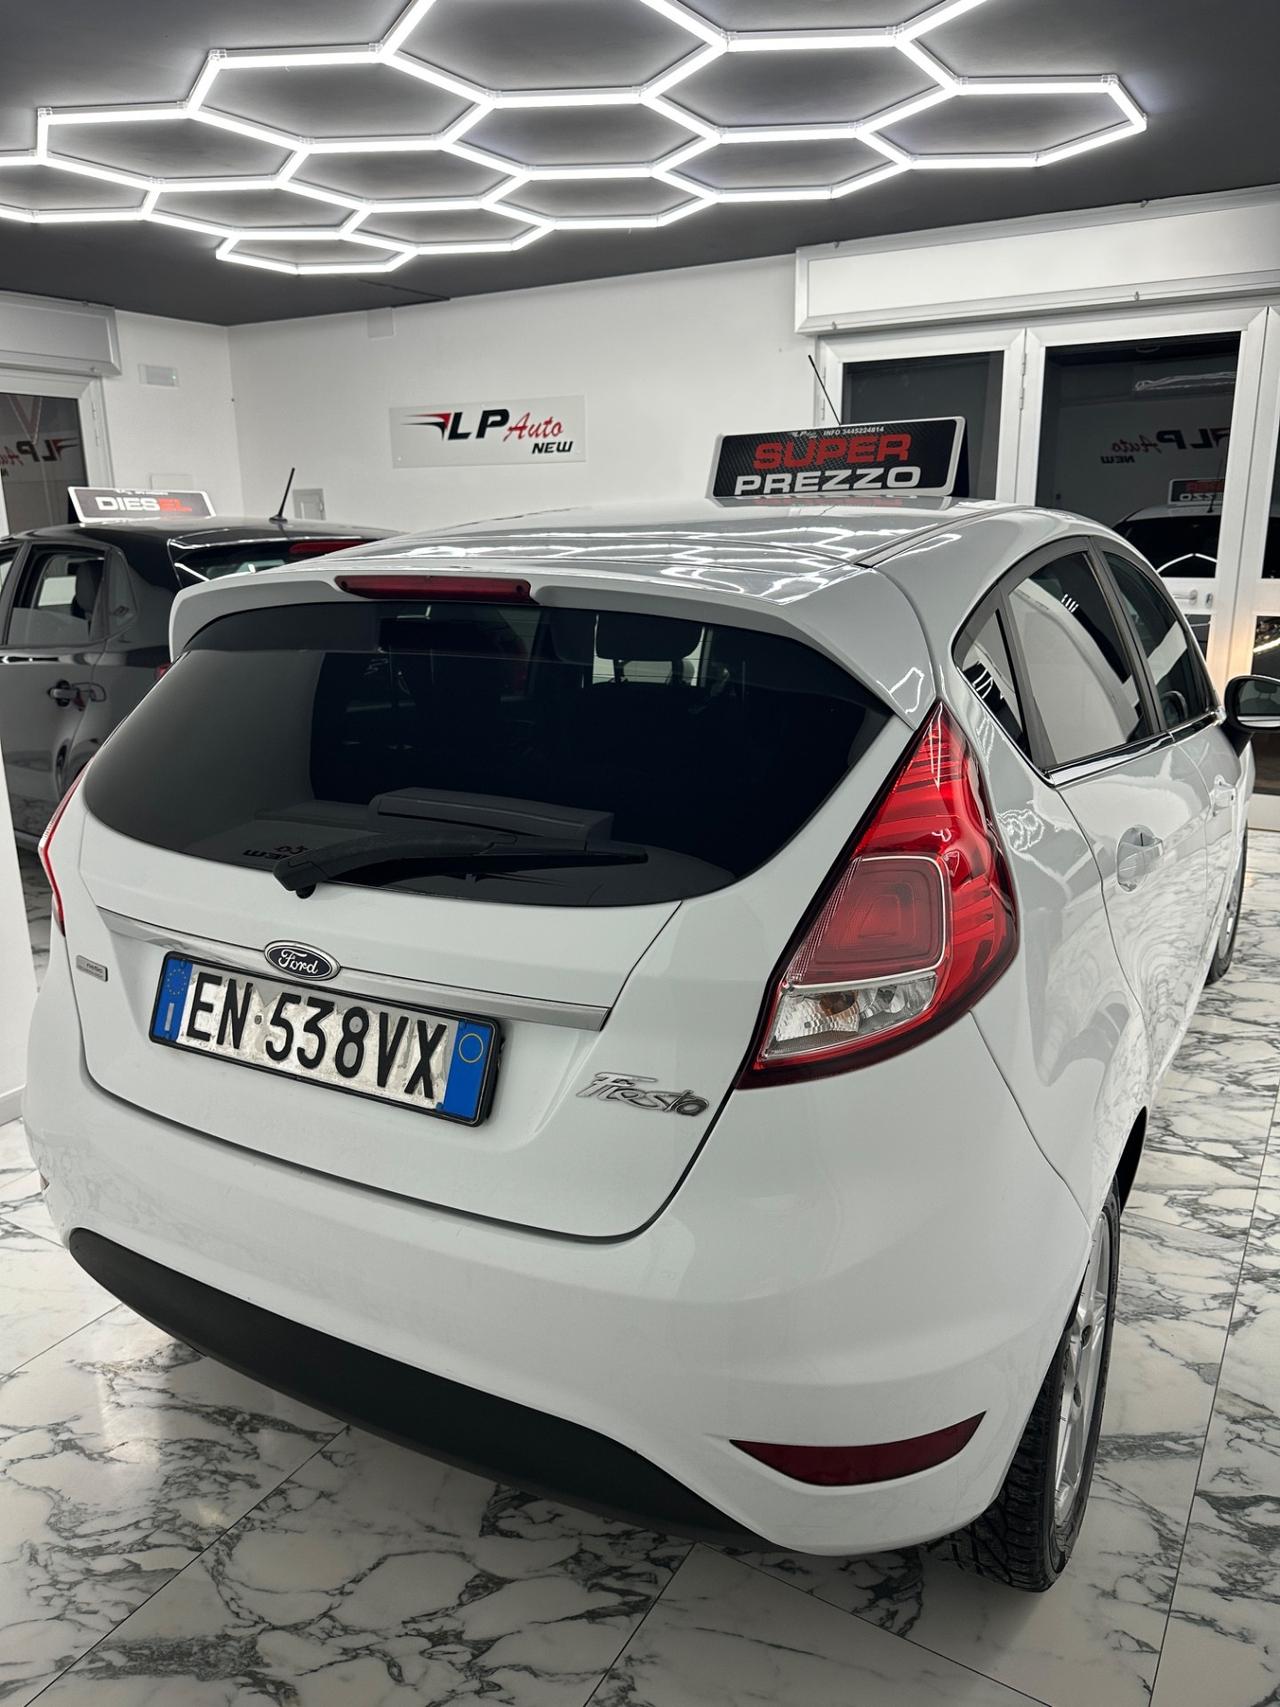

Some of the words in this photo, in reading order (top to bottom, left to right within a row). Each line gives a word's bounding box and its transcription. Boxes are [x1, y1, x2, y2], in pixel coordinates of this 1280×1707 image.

[448, 408, 510, 441] LP
[503, 412, 564, 442] Auto
[531, 441, 574, 455] NEW
[752, 433, 913, 470] SUPER
[734, 466, 922, 496] PREZZO
[95, 496, 193, 512] DIESEL
[277, 948, 320, 976] Ford
[186, 971, 254, 1050] EN
[265, 991, 448, 1100] 538VX
[576, 1072, 710, 1117] Fiesta
